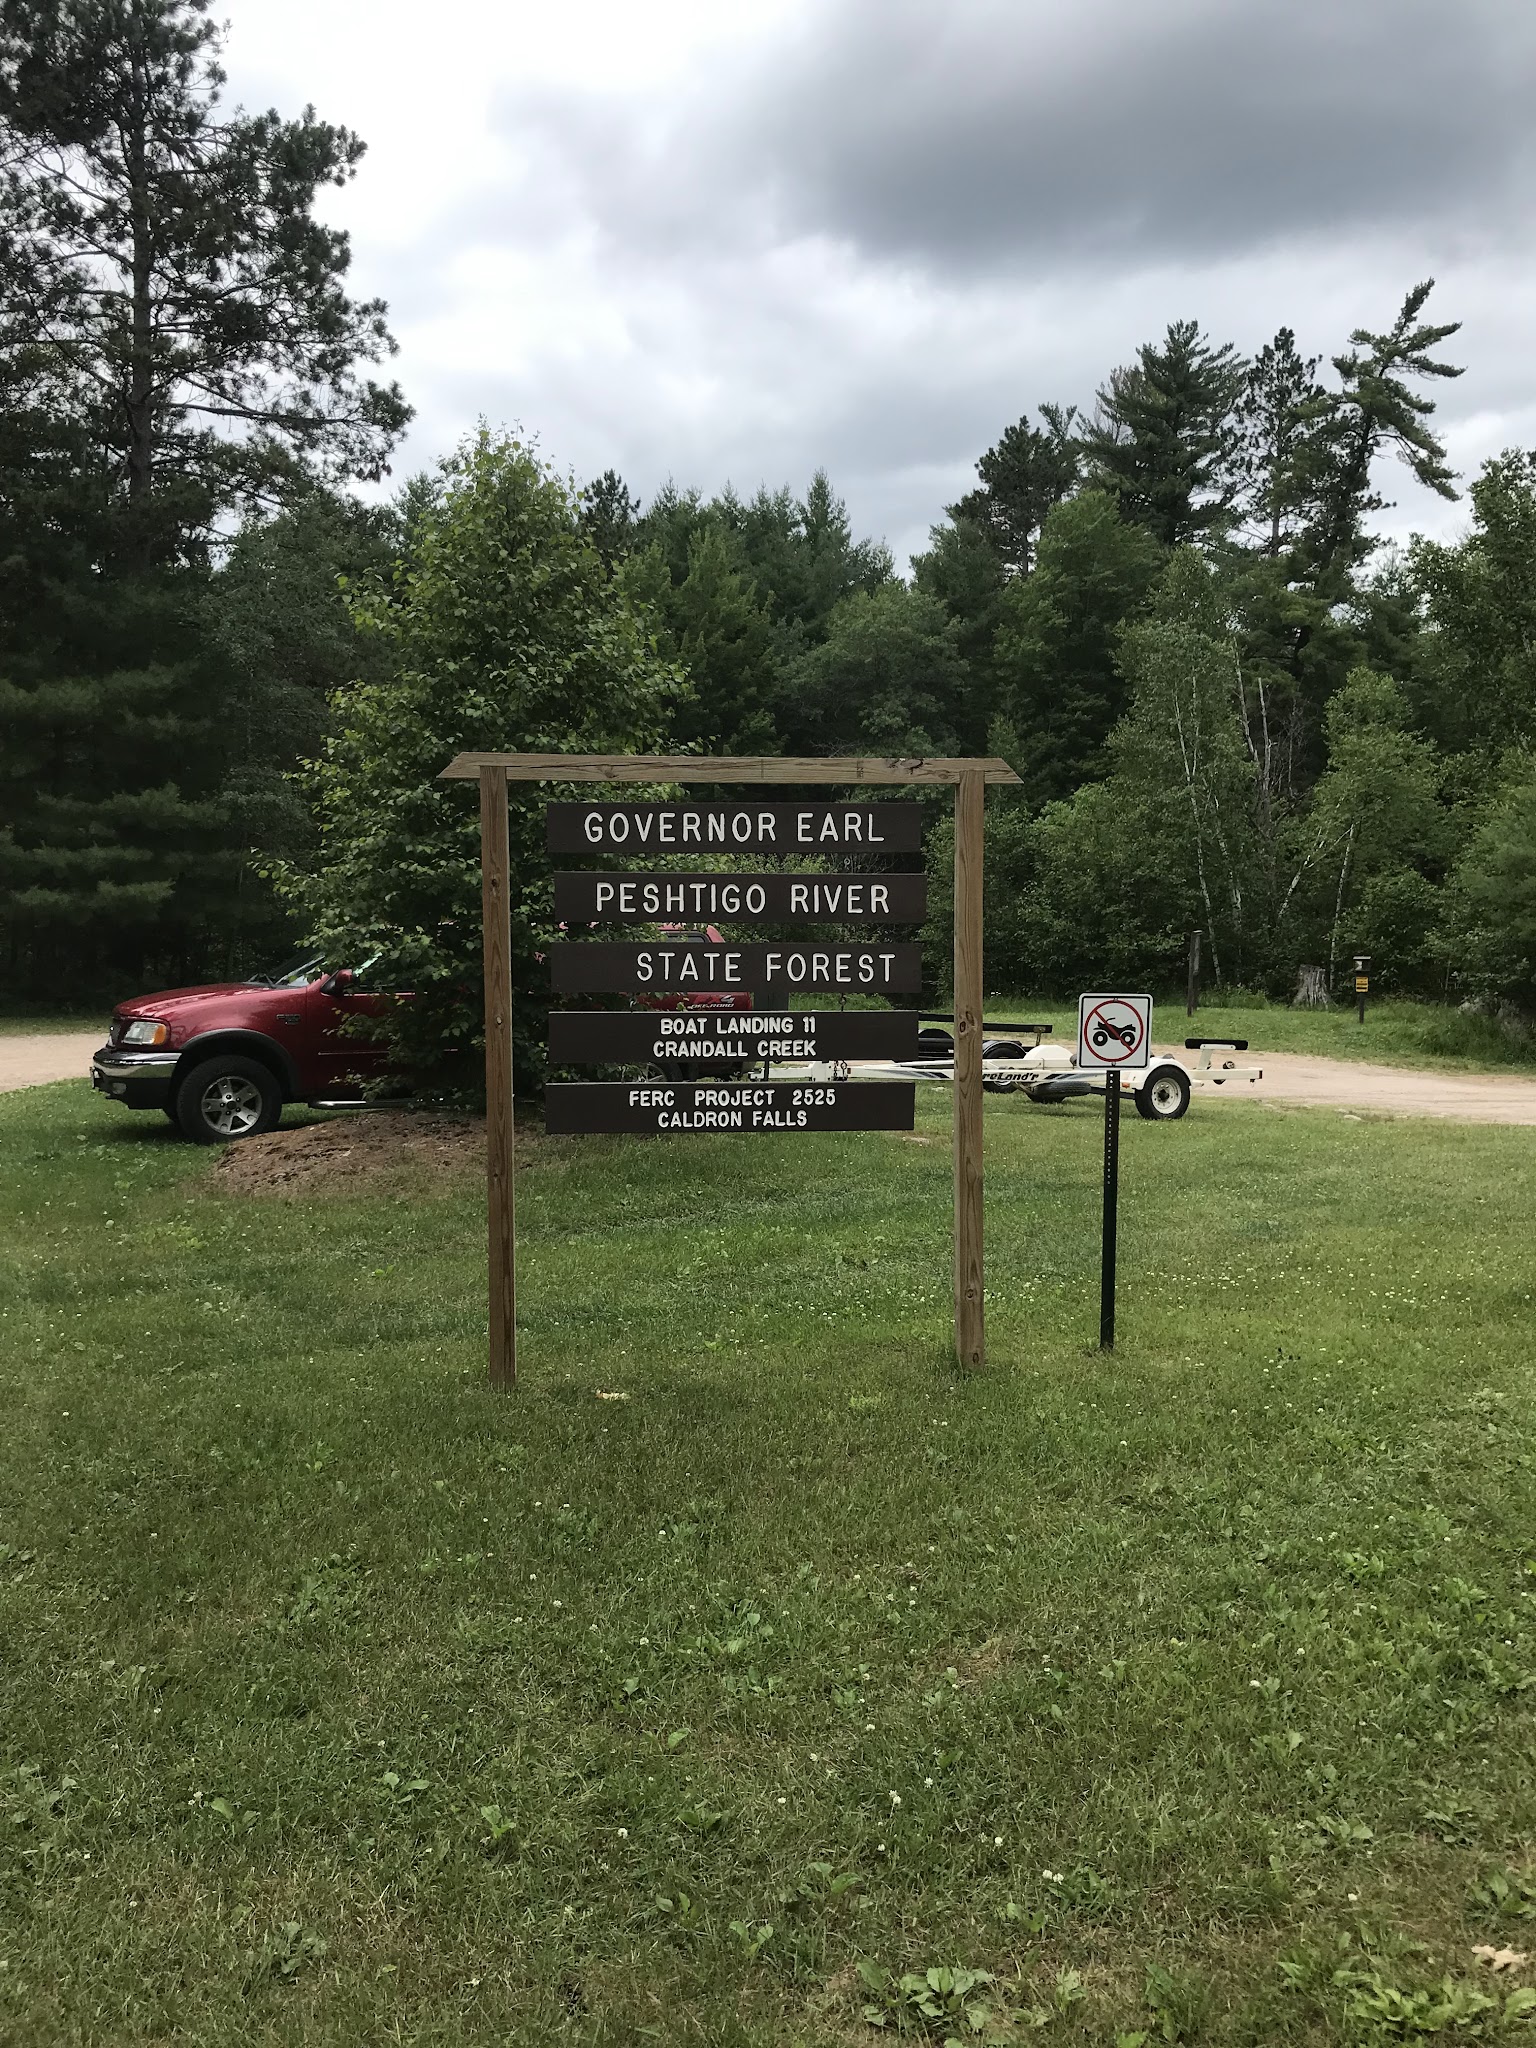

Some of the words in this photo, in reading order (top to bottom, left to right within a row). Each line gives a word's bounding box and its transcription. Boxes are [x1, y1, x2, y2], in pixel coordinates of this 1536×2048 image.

[585, 812, 776, 843] GOVERNOR
[797, 812, 885, 842] EARL
[596, 882, 766, 914] PESHTIGO
[791, 883, 890, 914] RIVER
[636, 952, 742, 982] STATE
[766, 953, 896, 983] FOREST
[660, 1017, 707, 1035] BOAT
[716, 1016, 793, 1034] LANDING
[803, 1016, 816, 1034] 11
[653, 1040, 748, 1058] CRANDALL
[757, 1040, 817, 1057] CREEK
[629, 1090, 675, 1107] FERC
[694, 1089, 775, 1106] PROJECT
[792, 1088, 836, 1105] 2525
[658, 1111, 742, 1128] CALDRON
[752, 1110, 808, 1127] FALLS
